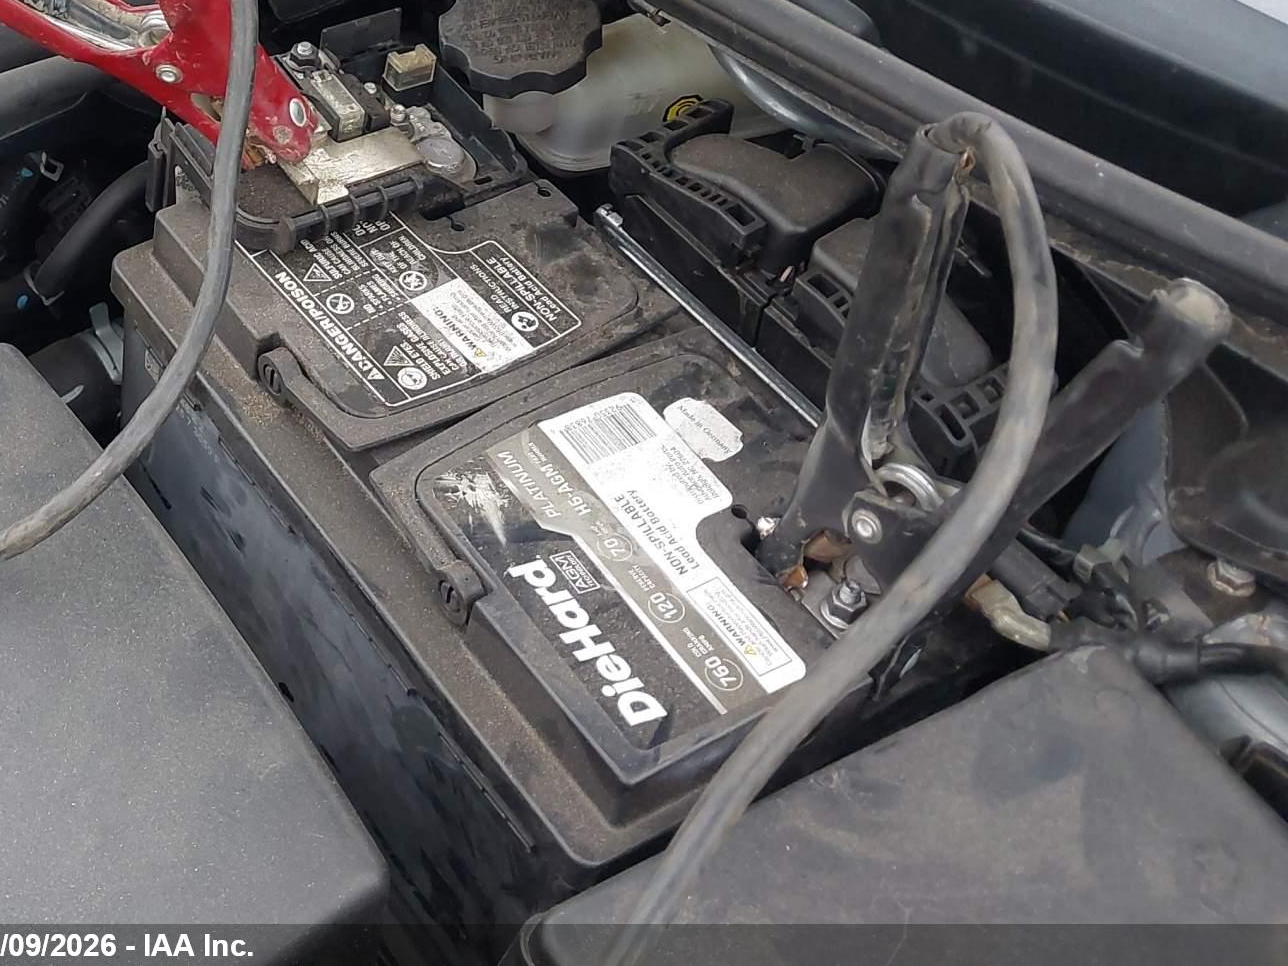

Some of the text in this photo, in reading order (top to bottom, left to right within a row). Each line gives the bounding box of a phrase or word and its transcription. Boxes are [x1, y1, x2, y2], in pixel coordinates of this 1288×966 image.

[312, 252, 344, 278] SULFURIC
[497, 256, 562, 312] Lead Acid Battery
[362, 303, 377, 313] NO
[484, 256, 558, 321] NON-SPILLABLE
[489, 294, 512, 312] READ
[272, 271, 375, 370] DANGER/POISON
[430, 306, 478, 349] WARNING:
[395, 322, 451, 374] EXPLOSIVE GASES
[414, 357, 441, 380] SHIELD
[676, 405, 698, 422] Made
[694, 419, 705, 428] in
[496, 448, 561, 520] PLATINUM
[540, 462, 591, 516] H6-AGM
[602, 536, 625, 556] 70
[613, 492, 689, 575] NON-SPILLABLE
[625, 486, 700, 570] Lead Acid Battery
[554, 554, 588, 590] AGM
[648, 590, 680, 619] 120
[506, 552, 669, 730] DieHard
[703, 654, 738, 687] 760
